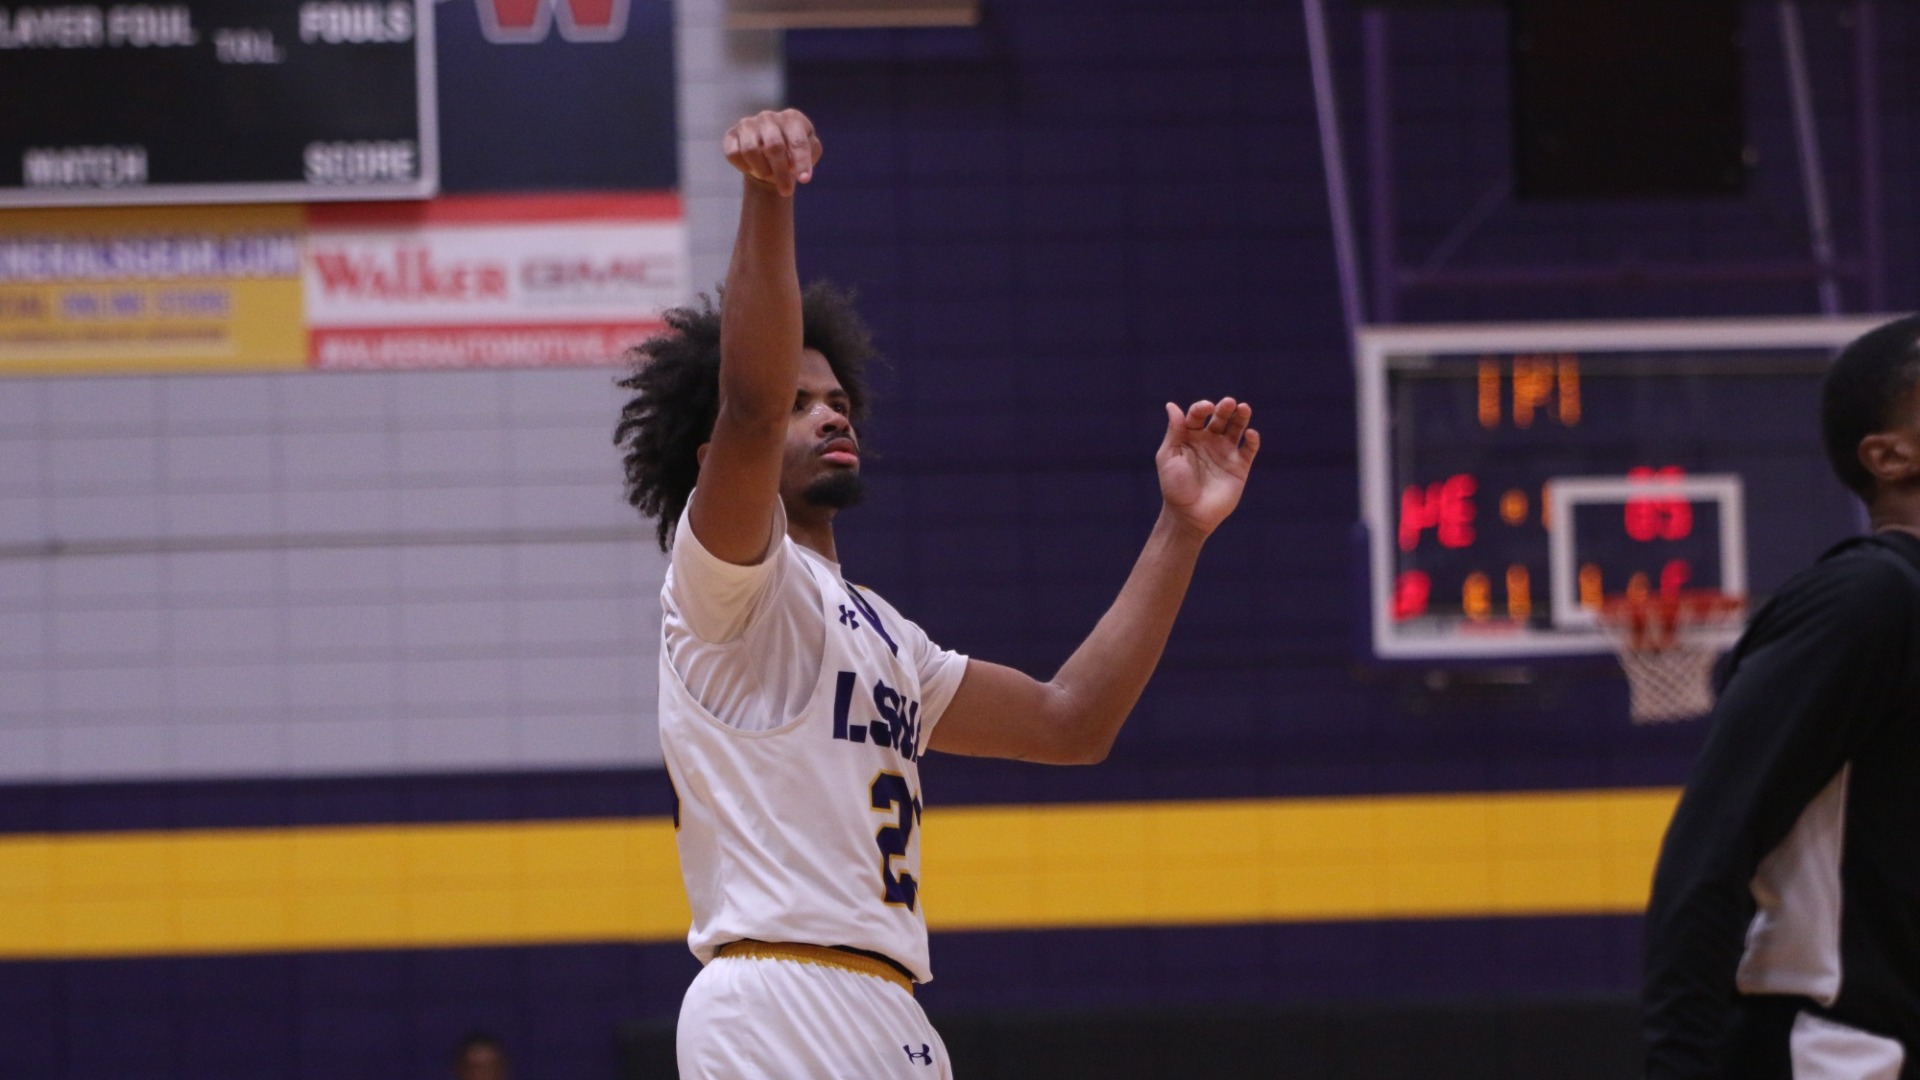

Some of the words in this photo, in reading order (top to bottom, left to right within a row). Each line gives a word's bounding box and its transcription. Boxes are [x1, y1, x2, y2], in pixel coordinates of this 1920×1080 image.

[108, 5, 197, 46] FOUL
[300, 3, 413, 42] FOULS
[23, 147, 147, 185] MATCH
[303, 142, 415, 182] SCORE
[314, 248, 508, 301] Walker
[521, 259, 675, 291] GMC
[833, 671, 922, 763] LSU
[868, 768, 923, 915] 2
